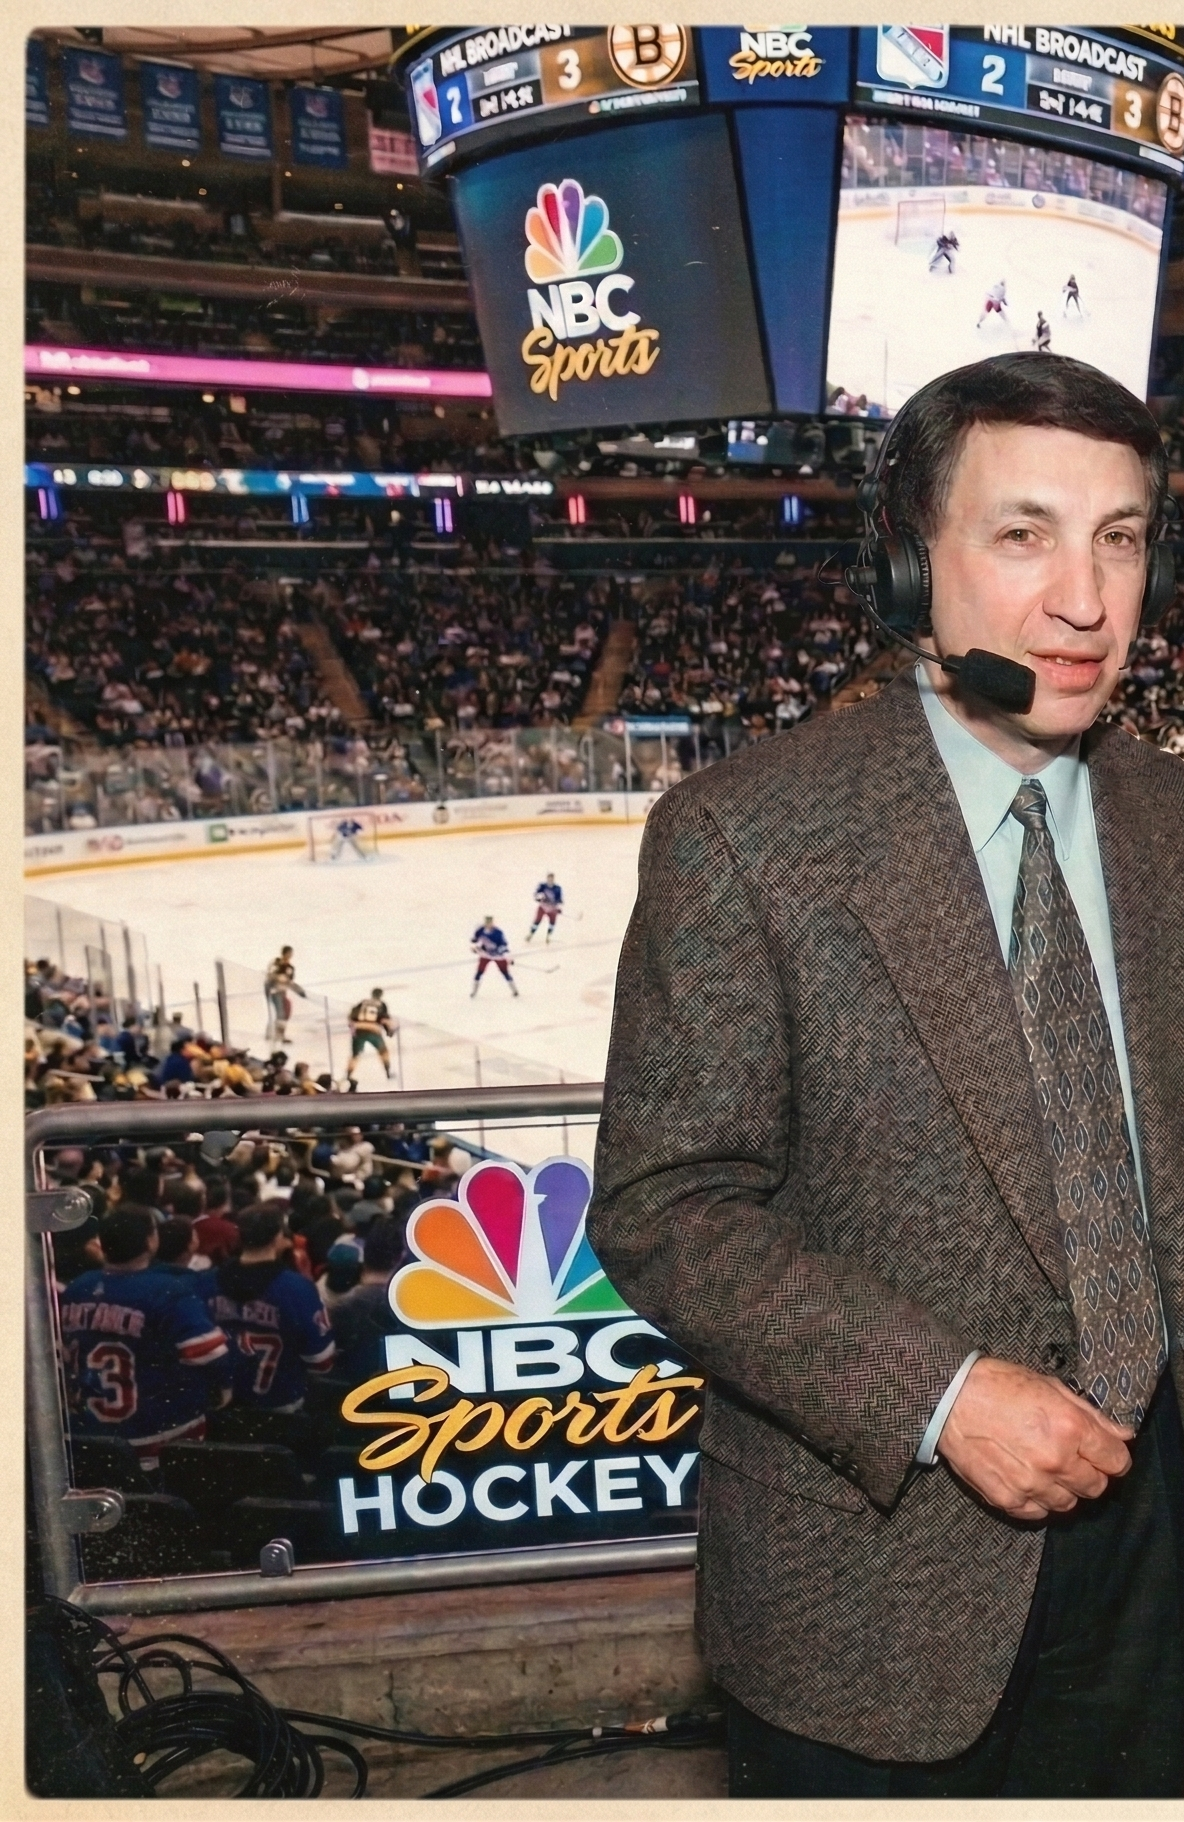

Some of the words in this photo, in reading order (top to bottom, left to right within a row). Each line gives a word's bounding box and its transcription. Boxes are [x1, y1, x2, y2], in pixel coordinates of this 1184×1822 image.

[465, 23, 571, 65] BROADCAST
[729, 50, 823, 85] Sports
[740, 32, 815, 58] NBC
[984, 23, 1031, 49] NHL
[1035, 28, 1147, 82] BROADCAST
[557, 49, 582, 91] 3
[981, 54, 1006, 96] 2
[1123, 91, 1143, 129] 3
[527, 273, 641, 340] NBC
[521, 324, 661, 402] Sports
[384, 1319, 684, 1400] NBC
[341, 1363, 705, 1485] Sports
[338, 1451, 701, 1534] HOCKEY
